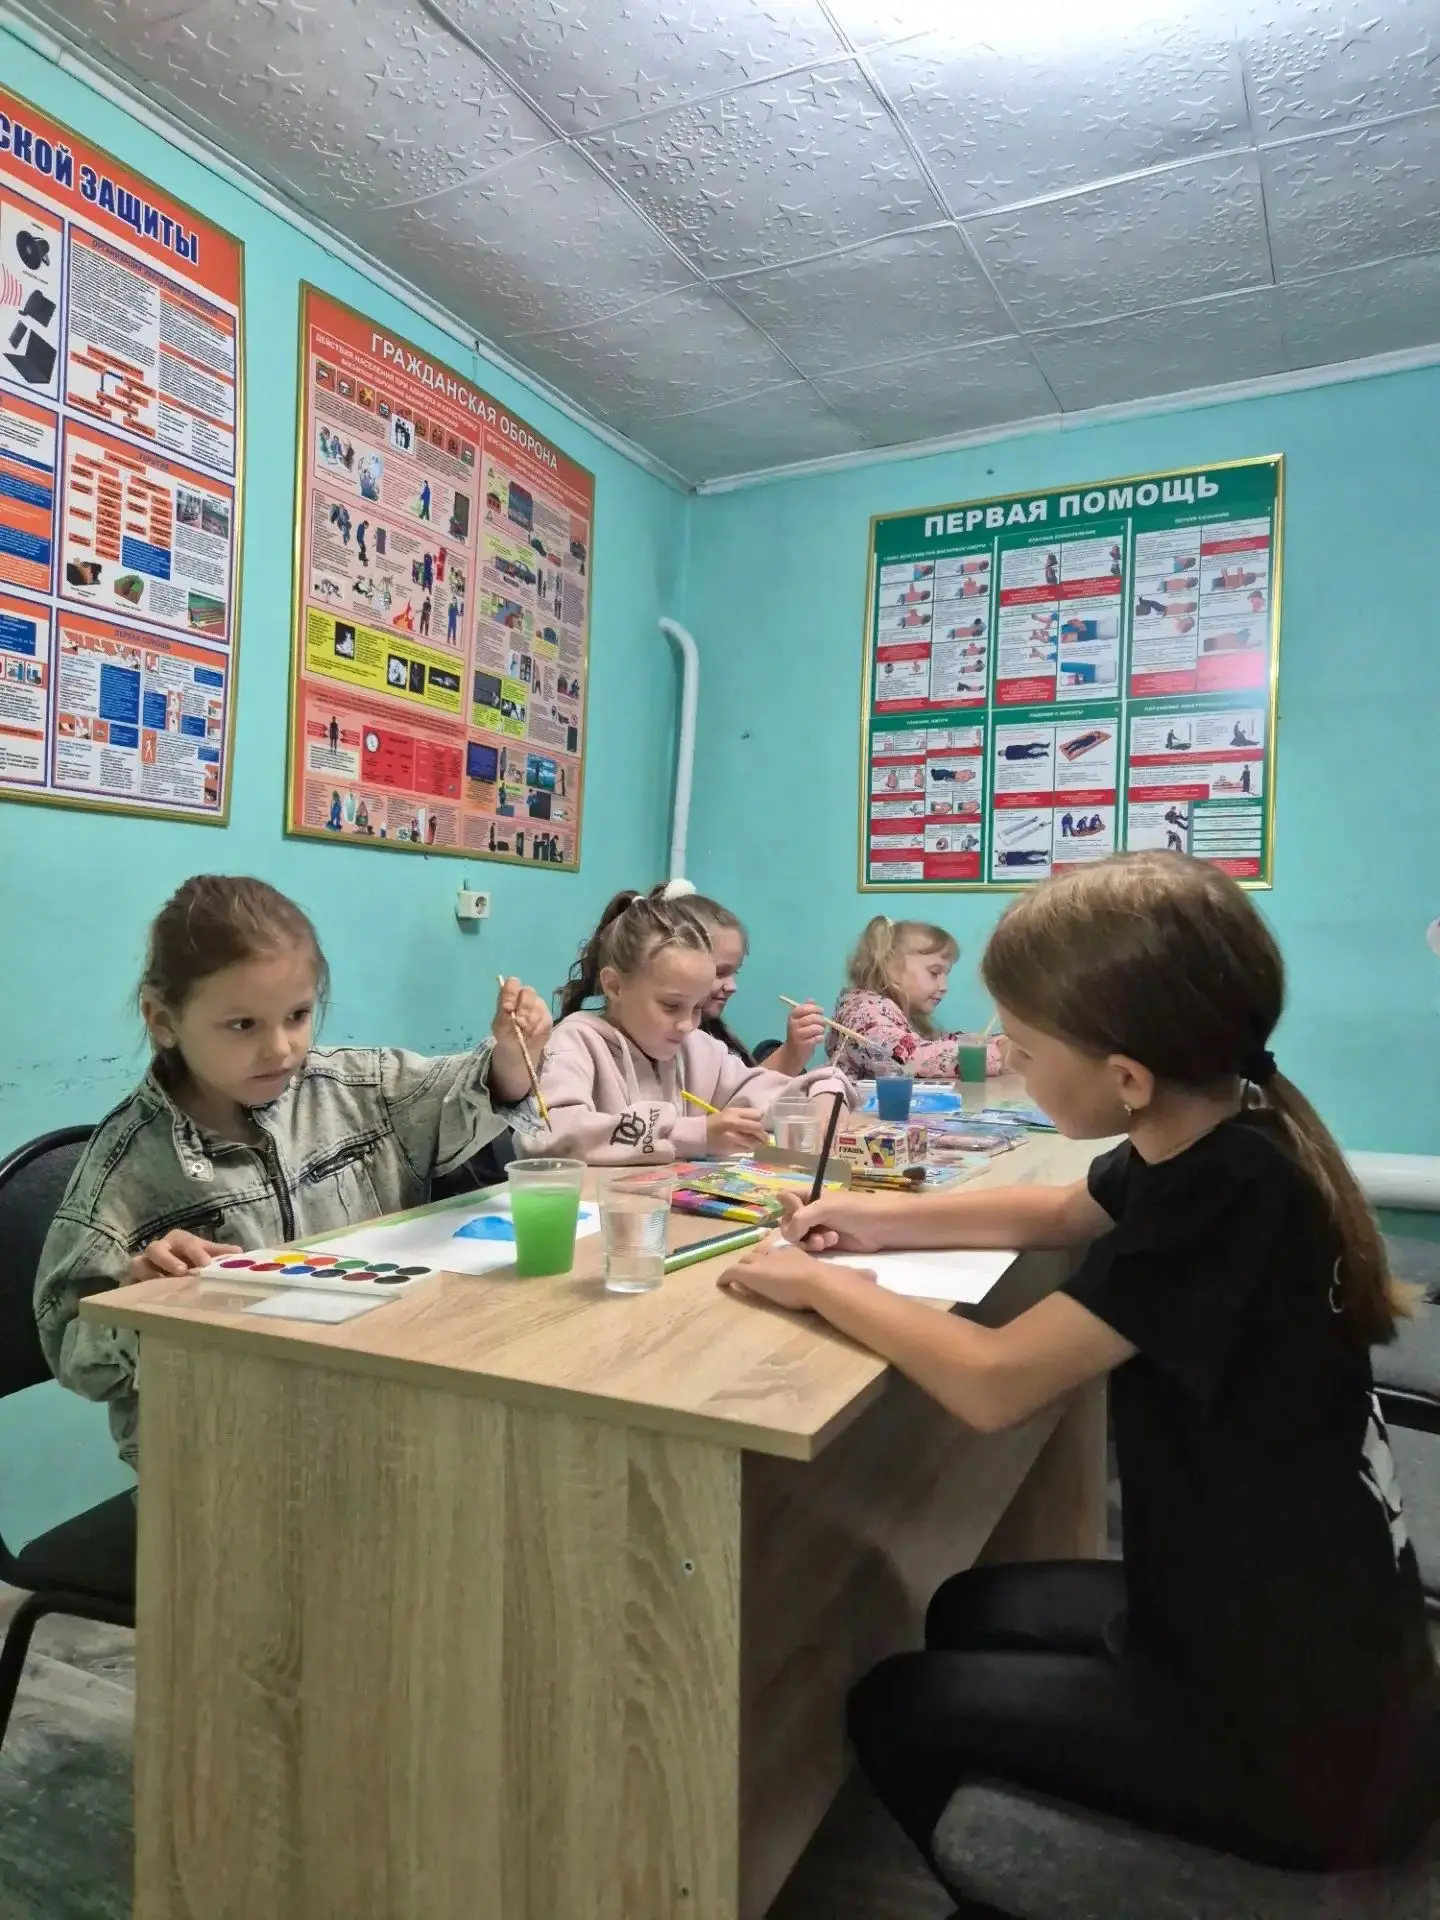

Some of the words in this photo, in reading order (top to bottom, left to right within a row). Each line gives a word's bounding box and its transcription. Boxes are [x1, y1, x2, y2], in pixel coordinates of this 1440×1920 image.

[79, 163, 199, 266] ЗАЩИТЫ
[371, 332, 497, 427] ГРАЖДАНСКАЯ
[500, 415, 558, 470] ОБОРОНА
[924, 499, 1048, 537] ПЕРВАЯ
[1059, 475, 1219, 518] ПОМОЩЬ
[839, 1146, 864, 1155] ГУАШЬ
